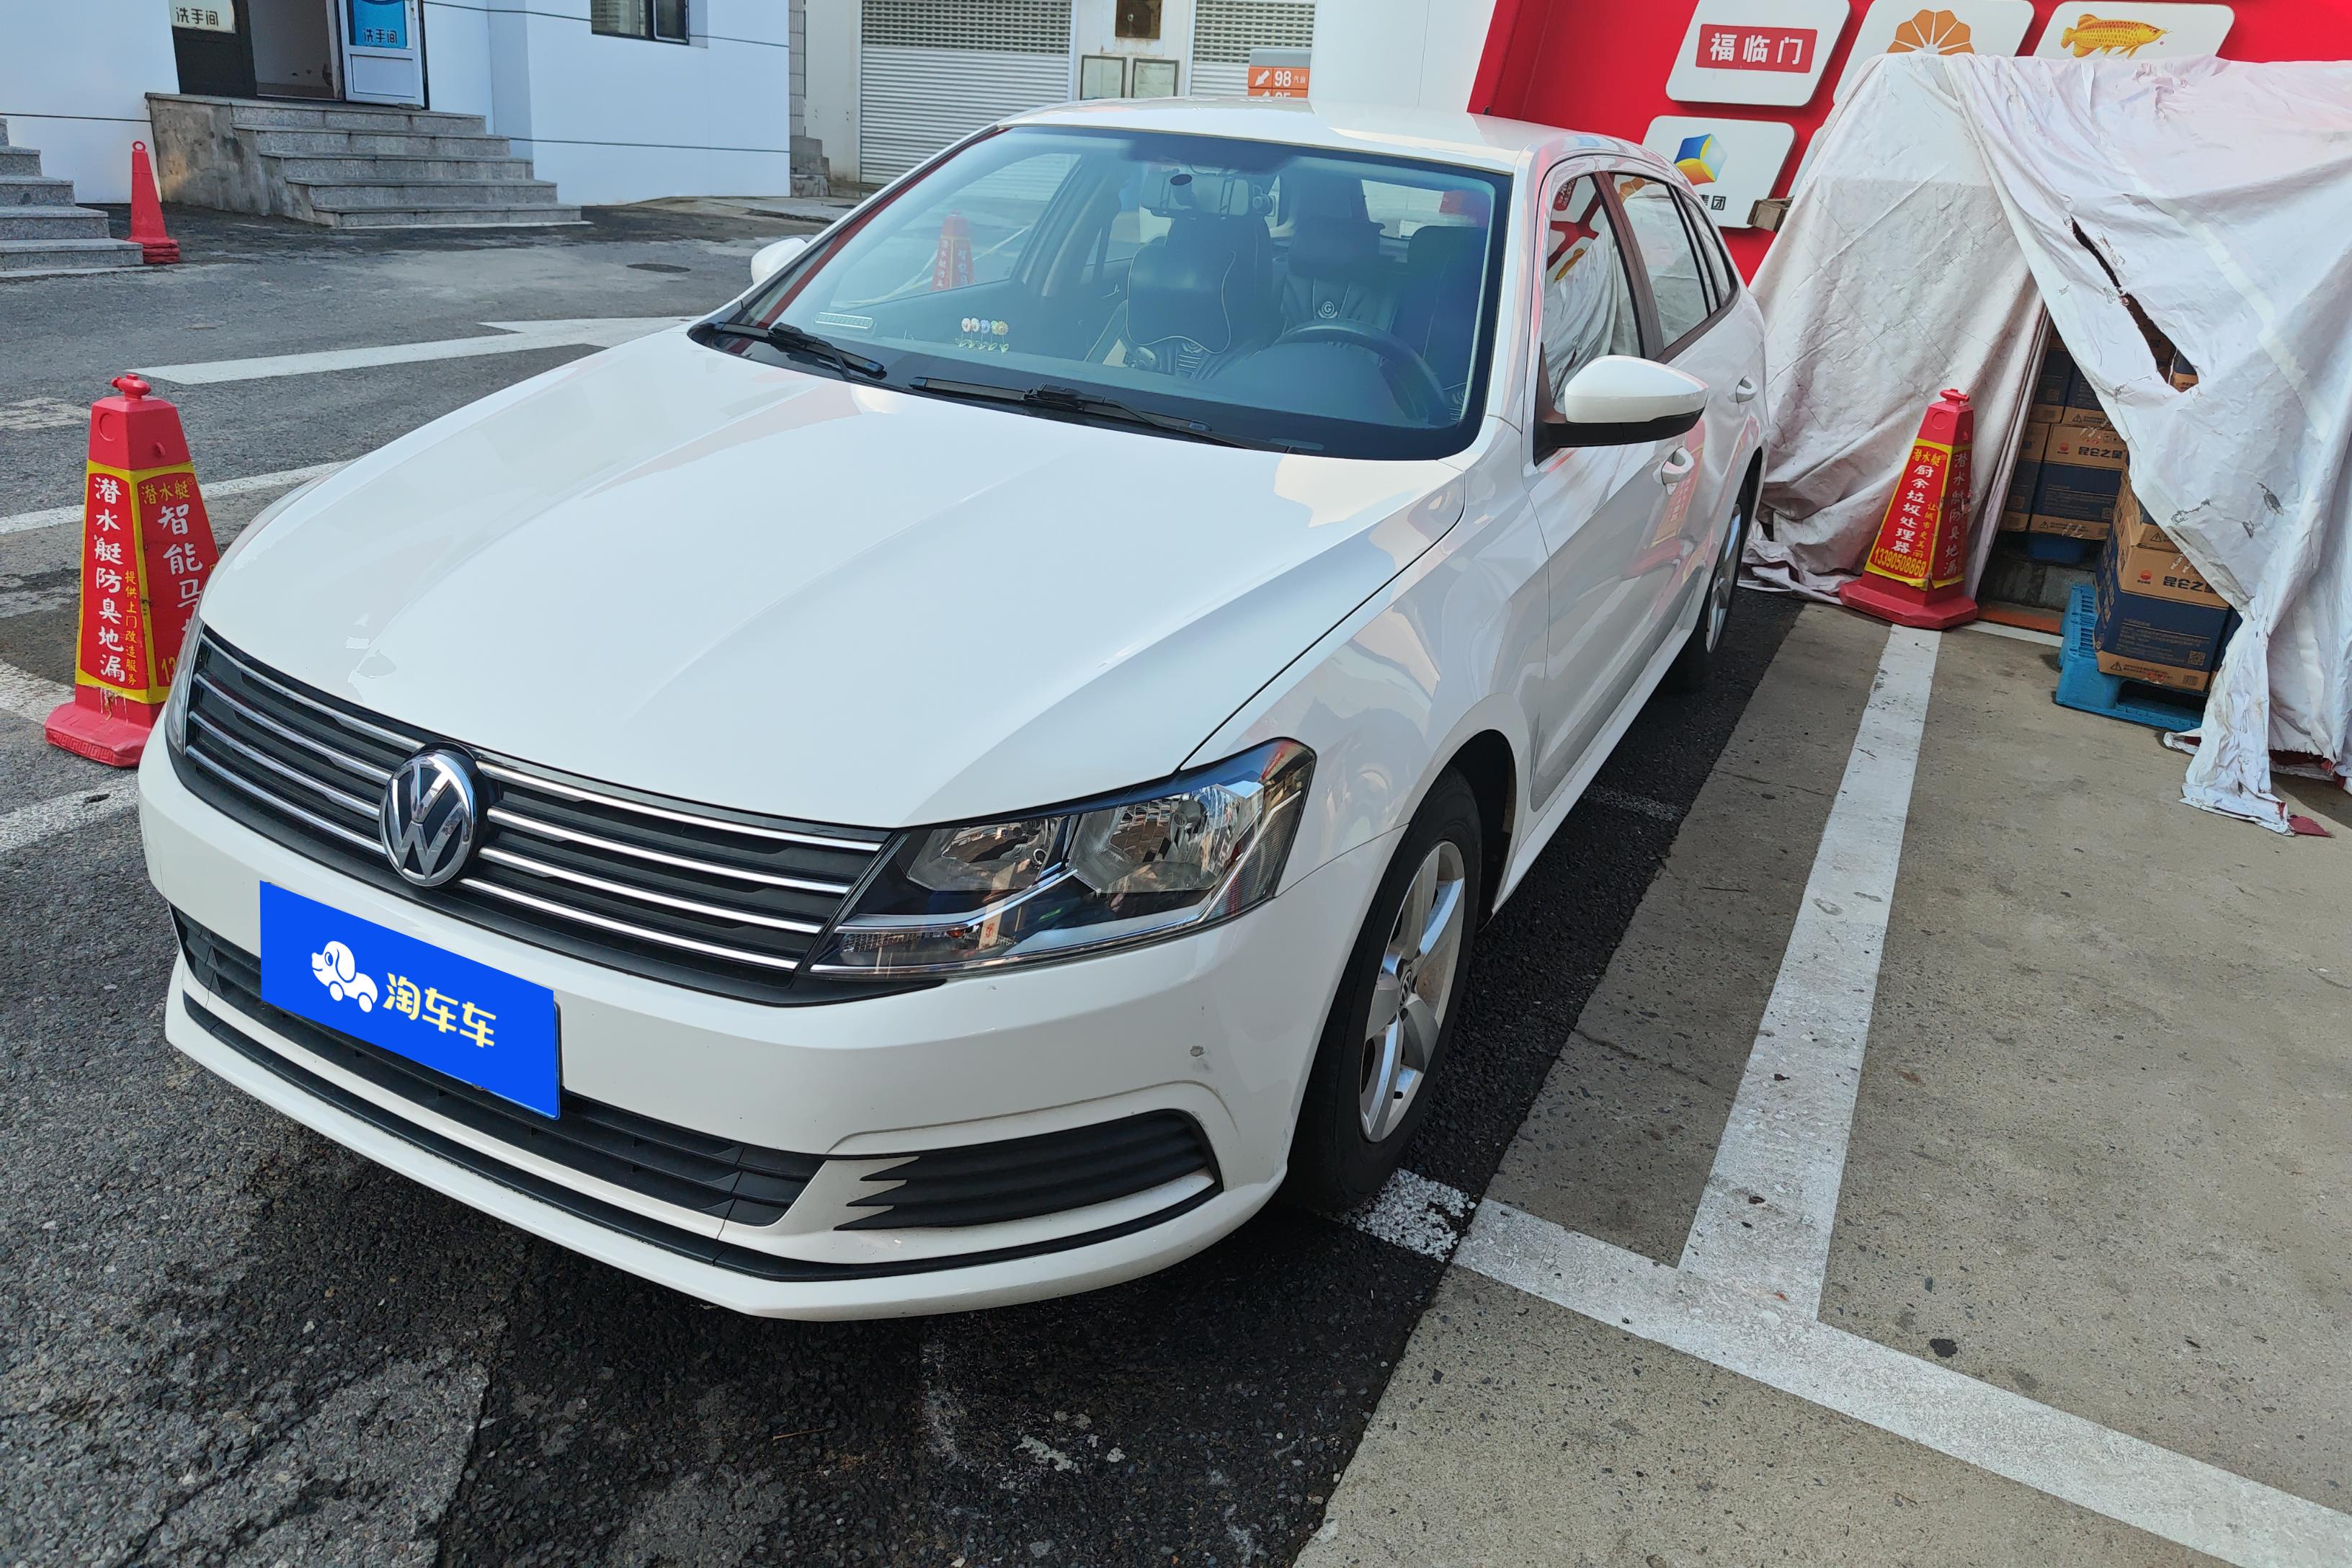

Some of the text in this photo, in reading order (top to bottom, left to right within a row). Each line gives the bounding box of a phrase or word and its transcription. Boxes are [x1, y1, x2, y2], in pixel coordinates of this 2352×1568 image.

[176, 7, 218, 27] 洗手间
[362, 27, 397, 45] 洗手间
[1710, 32, 1804, 65] 福临门
[1274, 71, 1292, 87] 98
[1891, 465, 1934, 554] 厨余垃圾处理器
[157, 504, 203, 632] 智能马
[1874, 546, 1927, 578] 13390508868
[94, 477, 125, 682] 潜水艇防臭地漏
[124, 569, 138, 686] 提供上门改造服务
